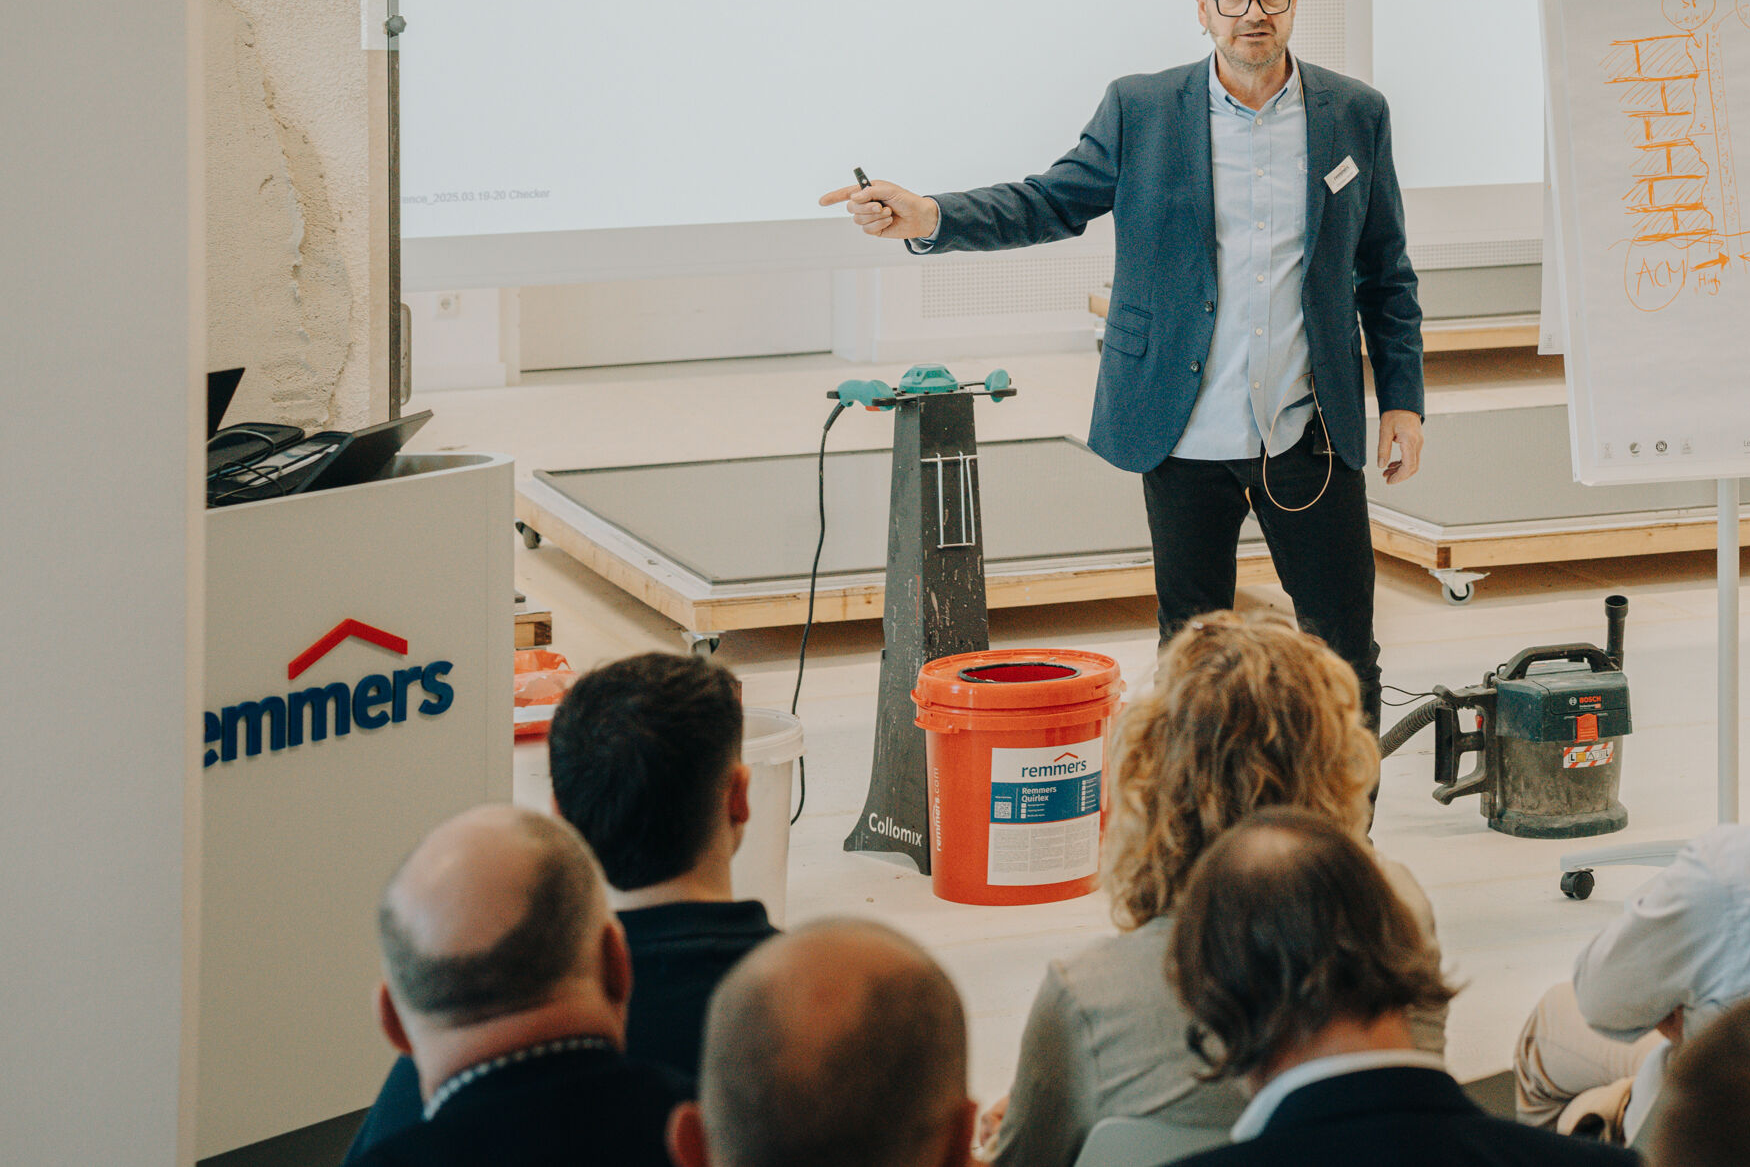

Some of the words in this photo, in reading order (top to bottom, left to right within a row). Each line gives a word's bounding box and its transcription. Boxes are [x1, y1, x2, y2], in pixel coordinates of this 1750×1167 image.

[1635, 258, 1686, 296] ACM
[1579, 695, 1601, 703] BOSCH
[1021, 760, 1087, 778] remmers
[1022, 786, 1057, 795] Remmers
[1021, 795, 1050, 803] Quirlex
[868, 812, 923, 847] Collomix
